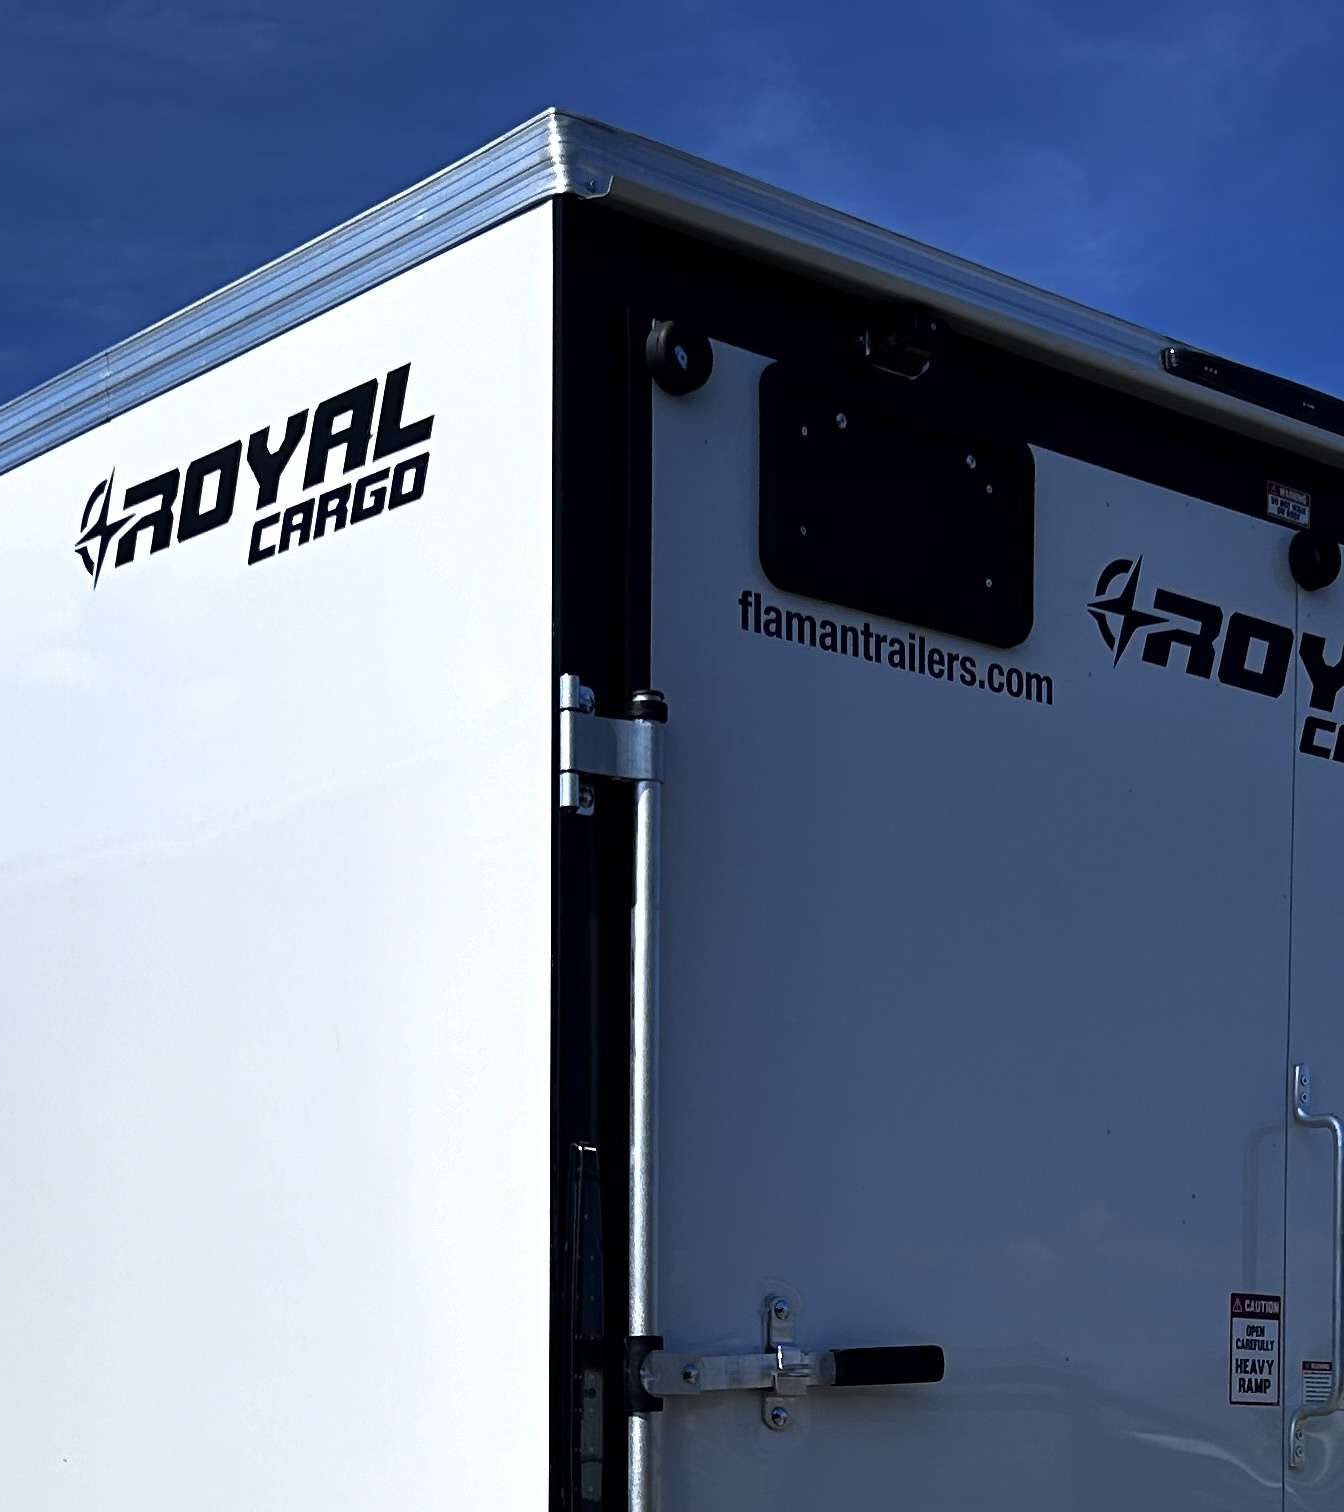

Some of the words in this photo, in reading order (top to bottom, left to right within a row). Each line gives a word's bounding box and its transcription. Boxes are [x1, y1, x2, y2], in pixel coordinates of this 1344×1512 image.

[115, 362, 435, 568] ROYAL
[248, 452, 430, 566] CARGO
[738, 590, 1054, 705] flamantrailers.com
[1245, 1299, 1279, 1313] CAUTION
[1246, 1325, 1265, 1337] OPEN
[1236, 1338, 1274, 1351] CAREFULLY
[1235, 1358, 1274, 1375] HEAVY
[1238, 1378, 1271, 1394] RAMP
